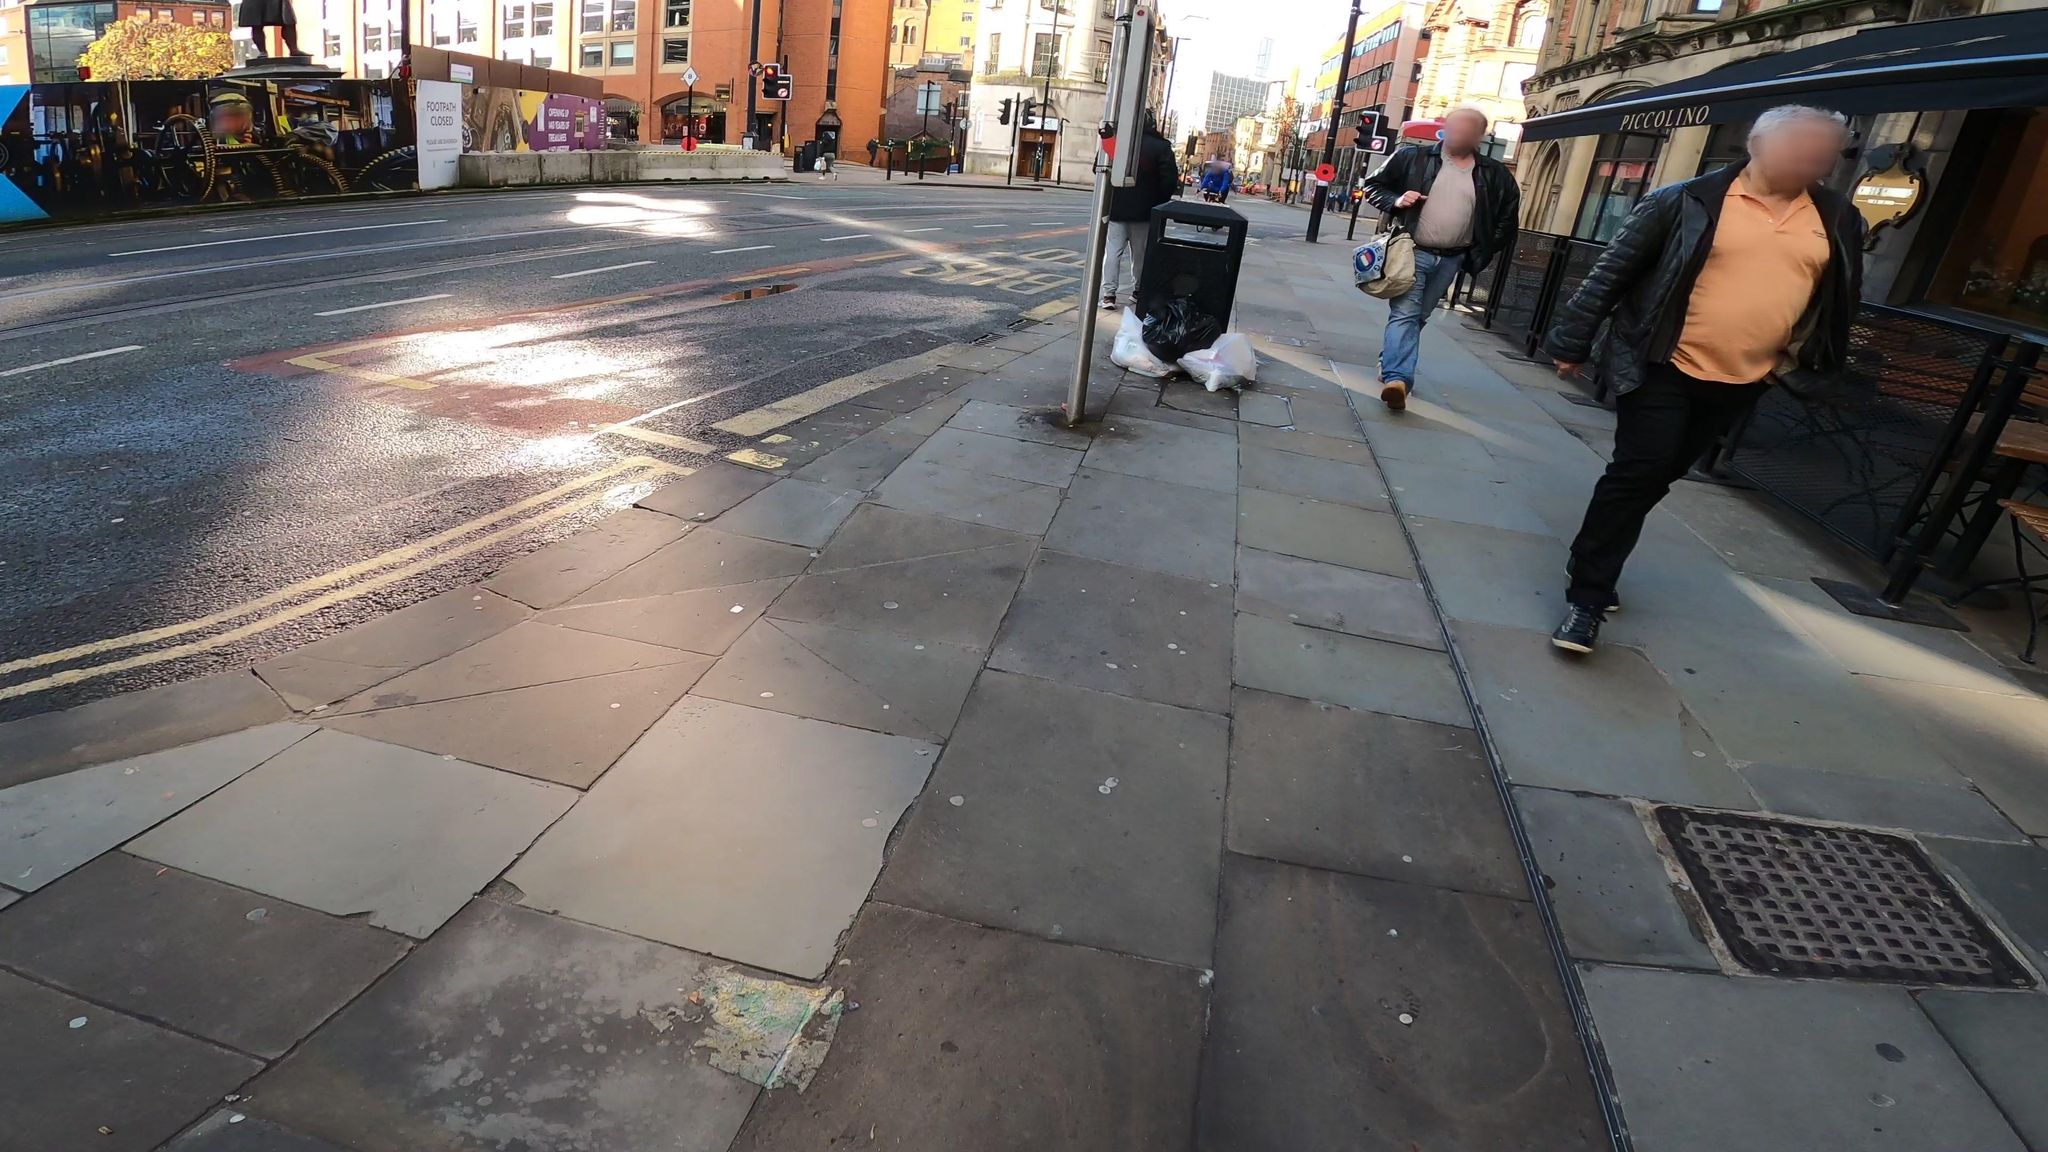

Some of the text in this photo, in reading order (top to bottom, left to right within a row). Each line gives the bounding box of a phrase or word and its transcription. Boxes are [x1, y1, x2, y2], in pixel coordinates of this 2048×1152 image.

[426, 101, 457, 112] FOOTPATH
[430, 115, 454, 127] CLOSED
[1619, 105, 1710, 131] PICCOLINO
